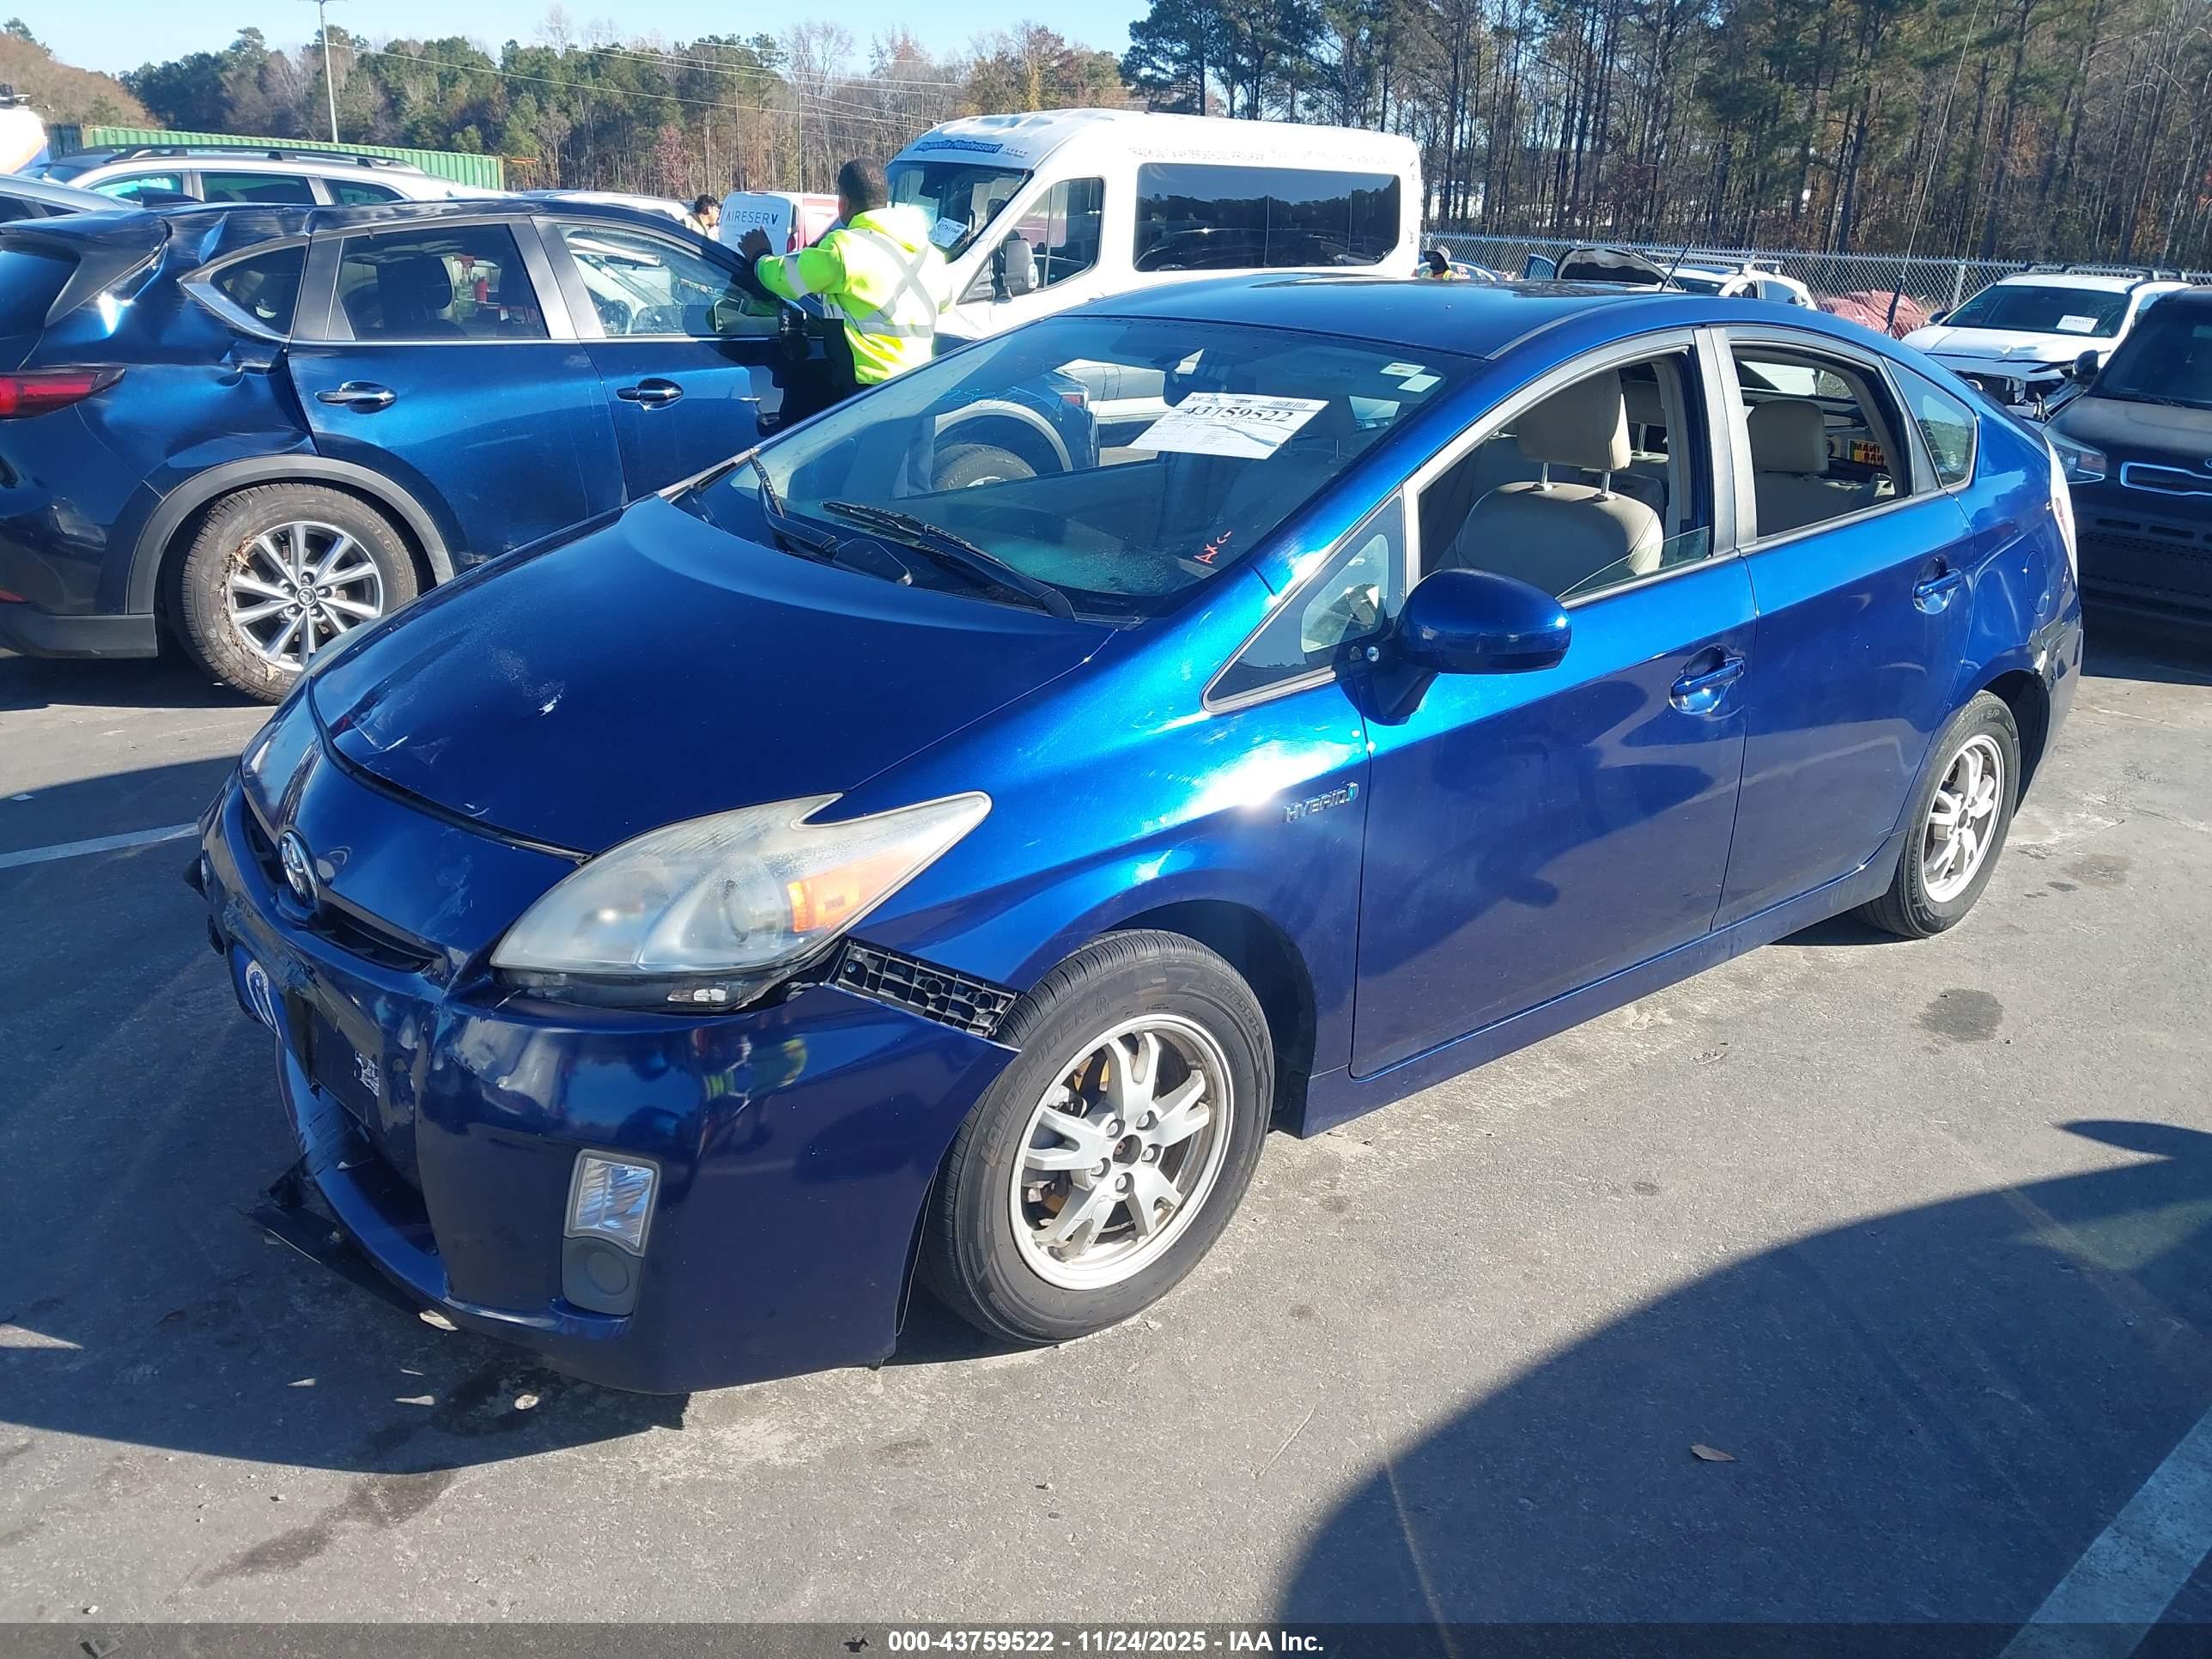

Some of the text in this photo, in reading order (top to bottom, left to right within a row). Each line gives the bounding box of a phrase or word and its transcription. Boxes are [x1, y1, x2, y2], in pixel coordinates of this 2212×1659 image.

[950, 141, 1001, 153] Montessori
[1184, 405, 1294, 422] 43759522
[1284, 788, 1348, 824] HYBRID
